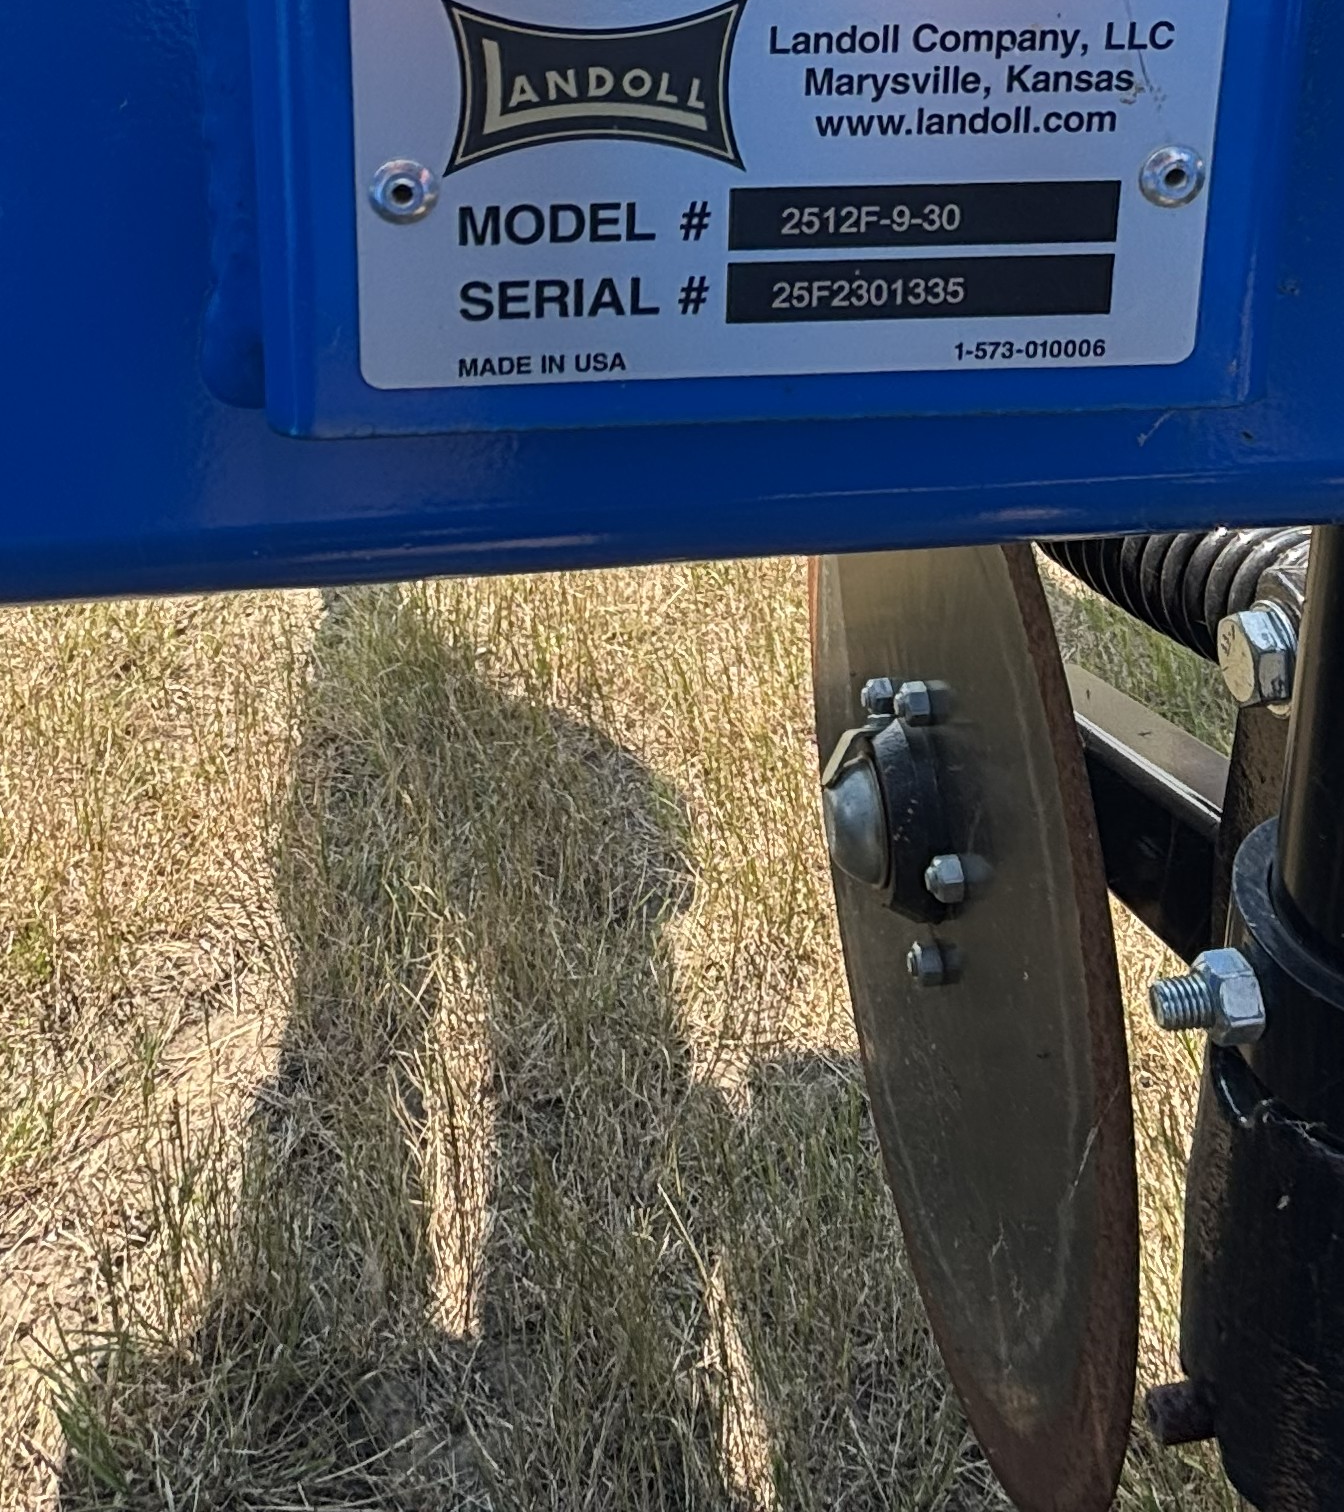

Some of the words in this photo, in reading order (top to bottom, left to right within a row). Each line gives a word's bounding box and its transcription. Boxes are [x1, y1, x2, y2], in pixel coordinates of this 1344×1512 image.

[769, 24, 899, 54] Landoll
[912, 23, 1089, 59] Company,
[1104, 20, 1175, 51] LLC
[482, 38, 708, 135] LANDOLL
[804, 65, 992, 103] Marysville,
[1006, 64, 1135, 94] Kansas
[815, 106, 1117, 137] www.landoll.com
[458, 202, 656, 246] MODEL
[679, 200, 712, 242] #
[781, 203, 961, 235] 2512F-9-30
[459, 276, 660, 321] SERIAL
[678, 275, 710, 315] #
[771, 277, 965, 309] 25F2301335
[458, 355, 532, 378] MADE
[541, 354, 566, 374] IN
[574, 352, 627, 372] USA
[954, 338, 1106, 361] 1-573-010006
